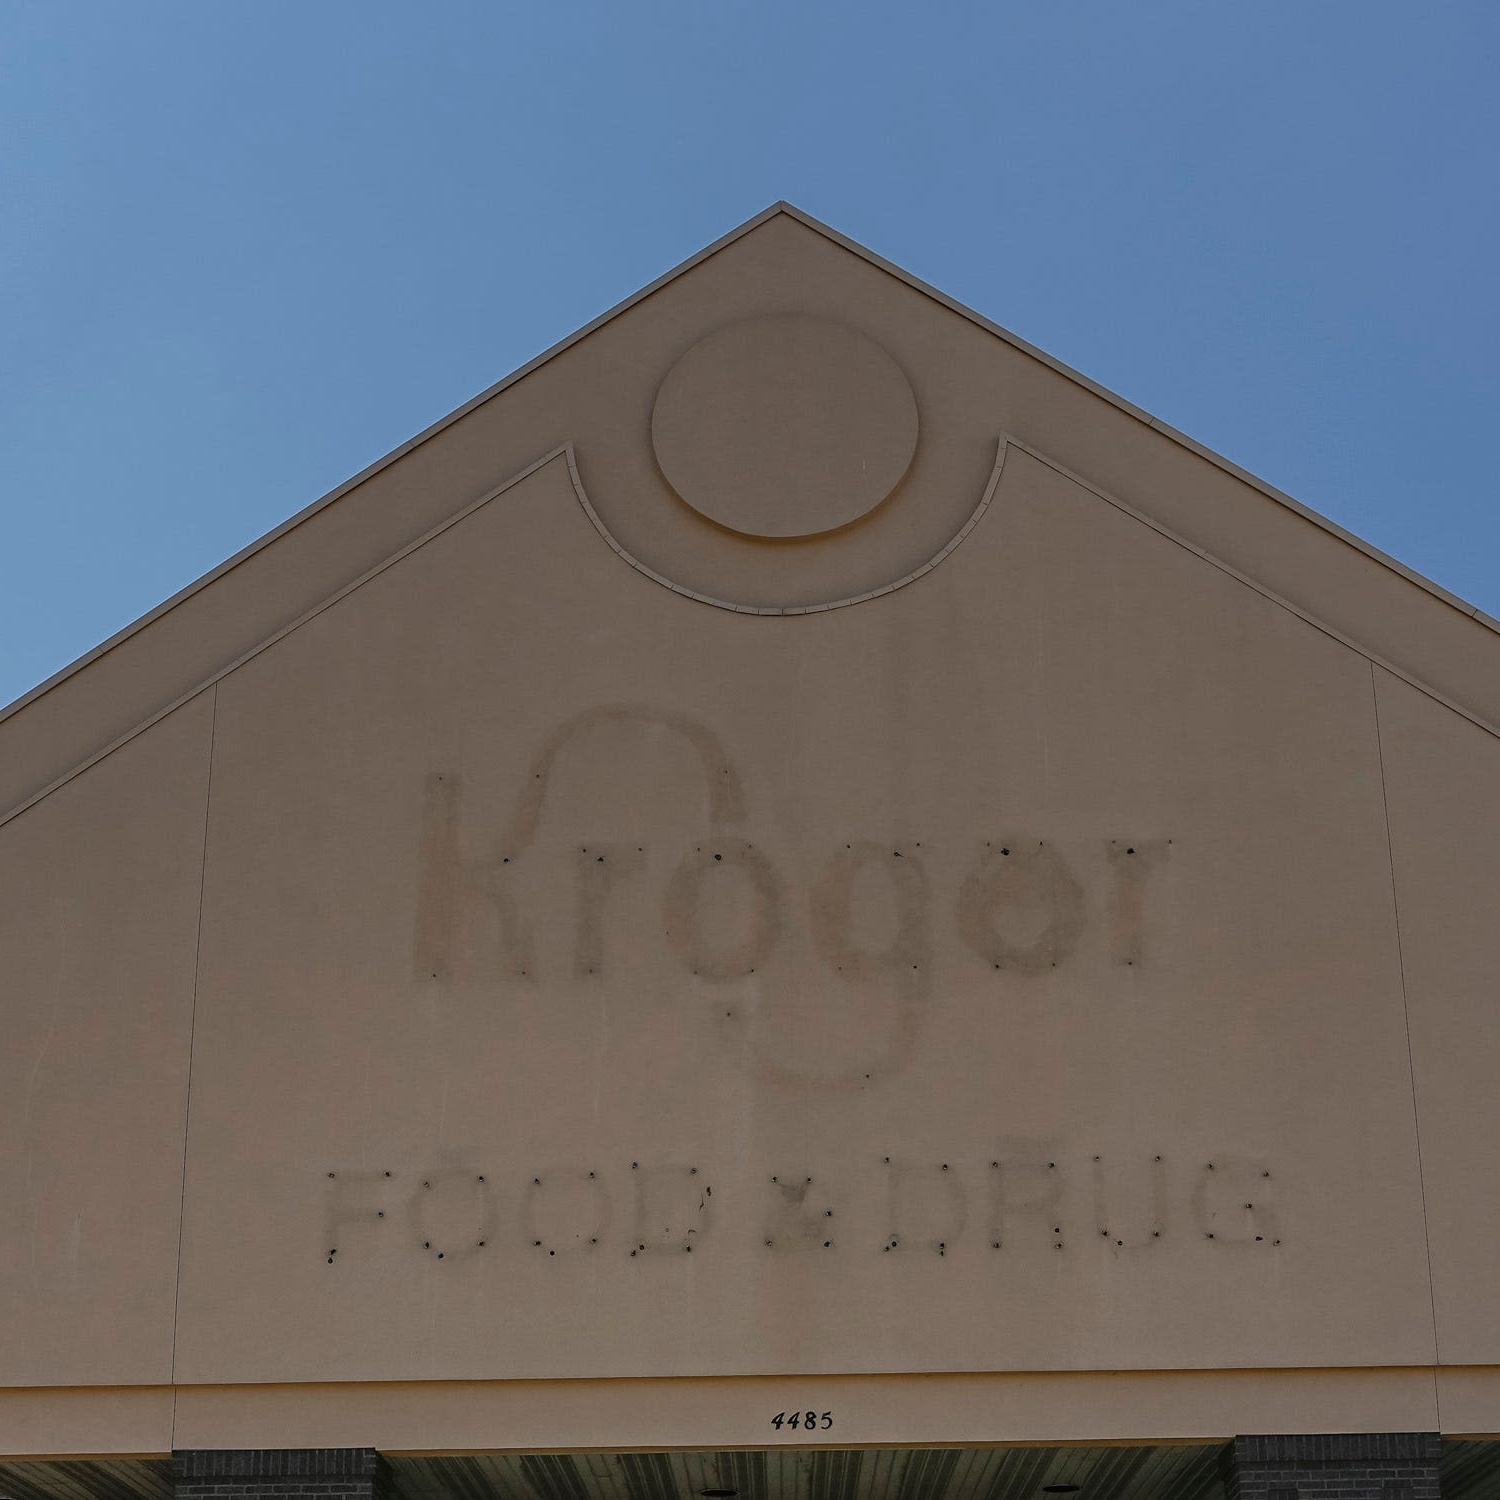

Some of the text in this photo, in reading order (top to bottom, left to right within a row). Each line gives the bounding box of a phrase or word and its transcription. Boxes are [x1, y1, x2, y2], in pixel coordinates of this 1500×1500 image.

[412, 701, 1176, 1093] Kroger
[322, 1158, 715, 1267] FOOD
[878, 1150, 1287, 1262] DRUG
[770, 1411, 833, 1431] 4485
